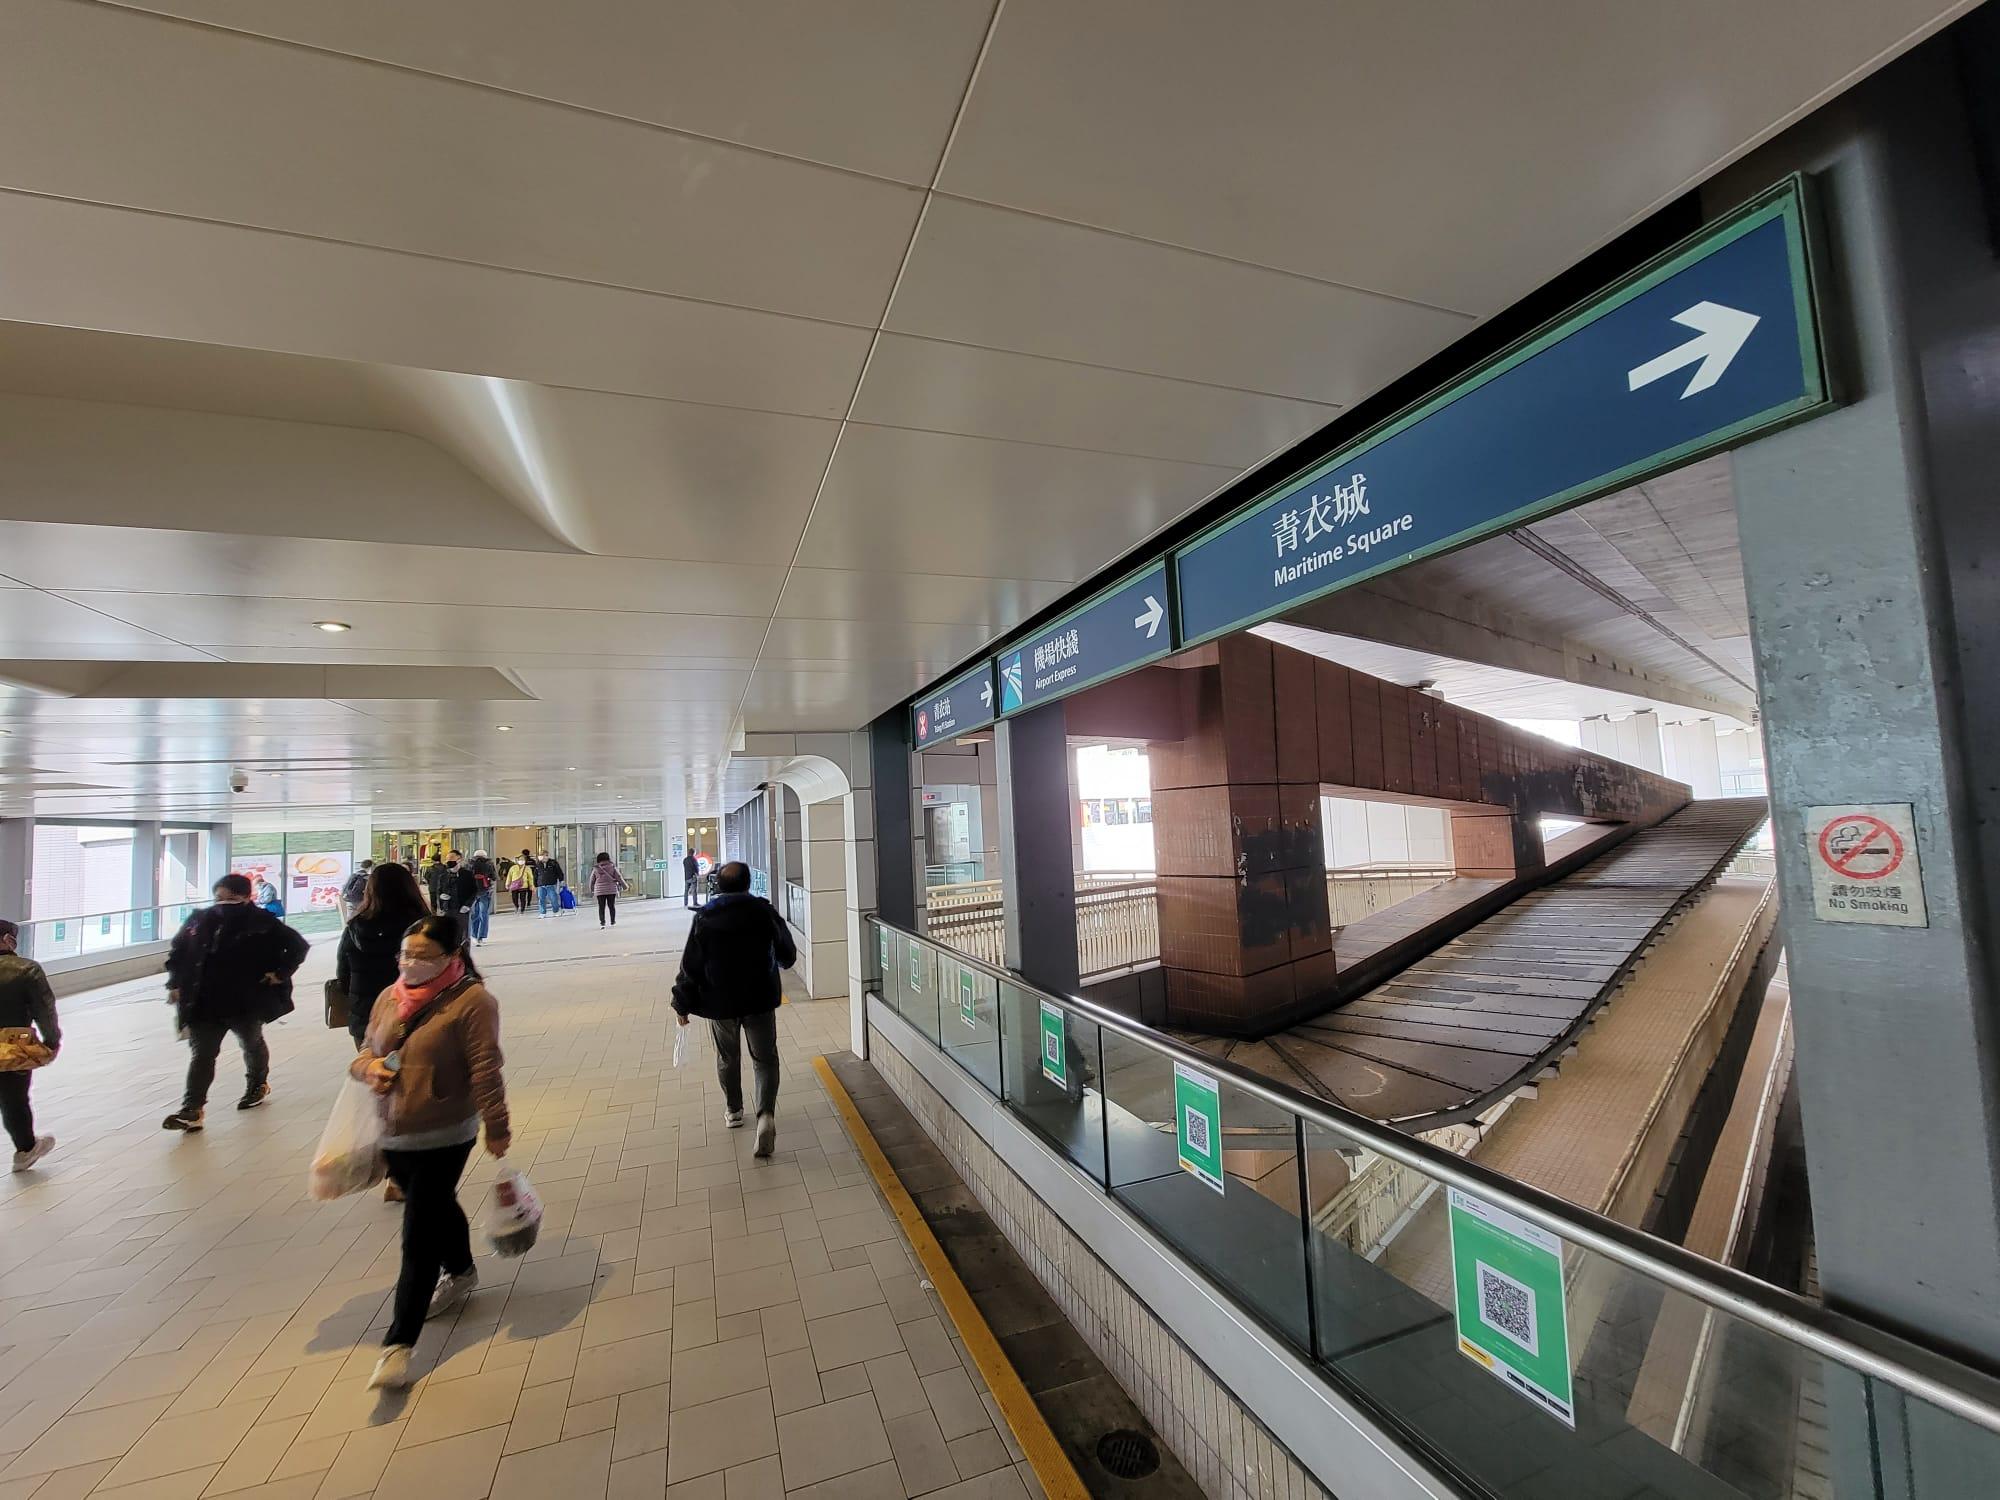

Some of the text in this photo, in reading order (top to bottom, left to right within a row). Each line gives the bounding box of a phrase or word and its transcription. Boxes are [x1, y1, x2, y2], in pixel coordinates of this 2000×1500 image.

[1272, 473, 1370, 557] 青衣城
[1274, 514, 1413, 587] Maritime Square
[1035, 665, 1077, 690] Airport Express
[1829, 898, 1908, 914] No Smoking
